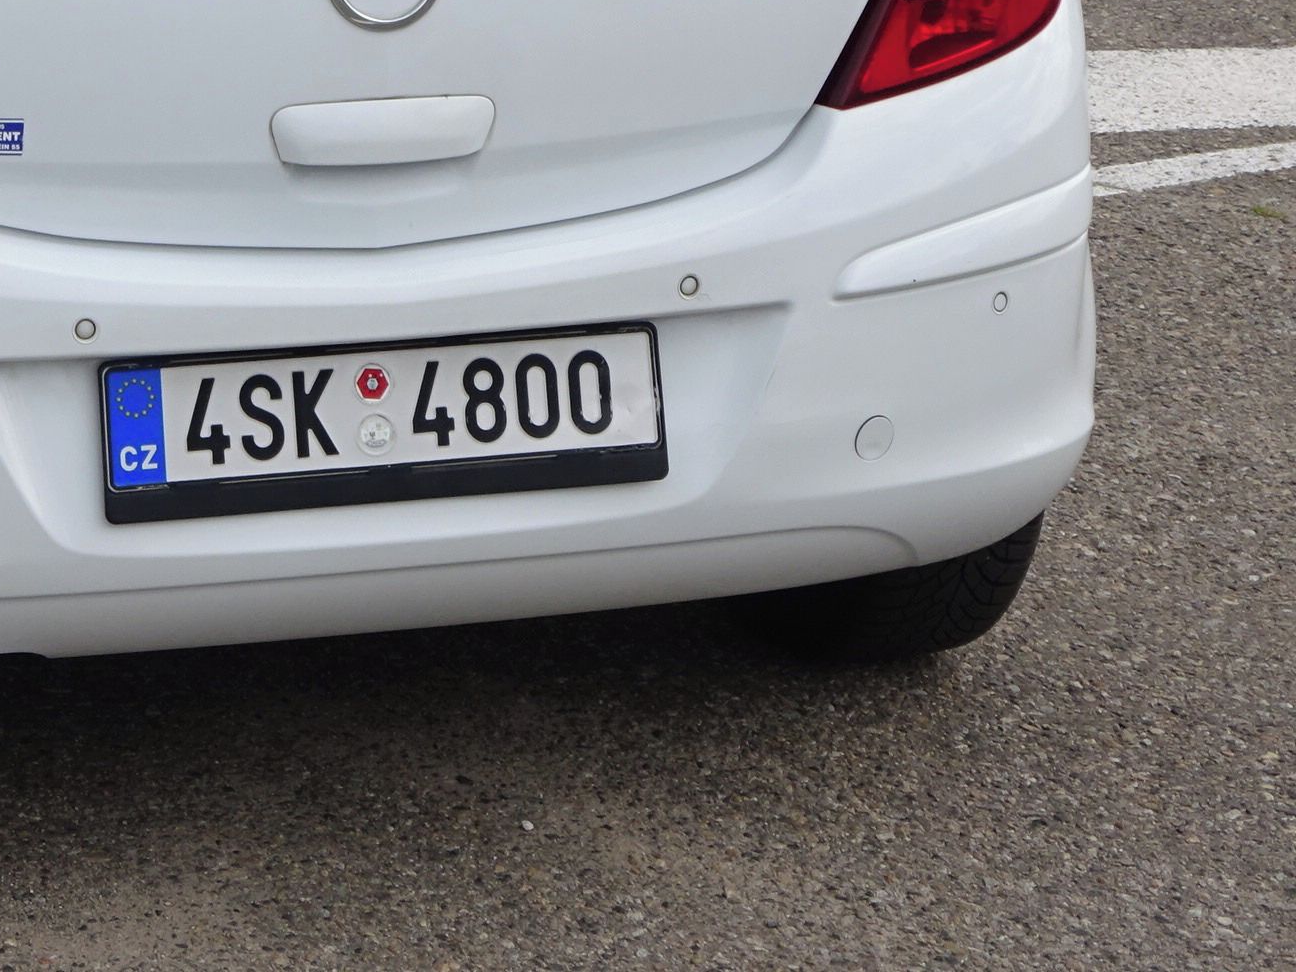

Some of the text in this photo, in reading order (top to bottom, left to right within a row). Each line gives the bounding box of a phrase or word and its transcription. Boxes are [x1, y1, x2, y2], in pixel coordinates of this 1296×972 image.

[185, 349, 614, 466] 4SK 4800
[119, 443, 160, 473] CZ
